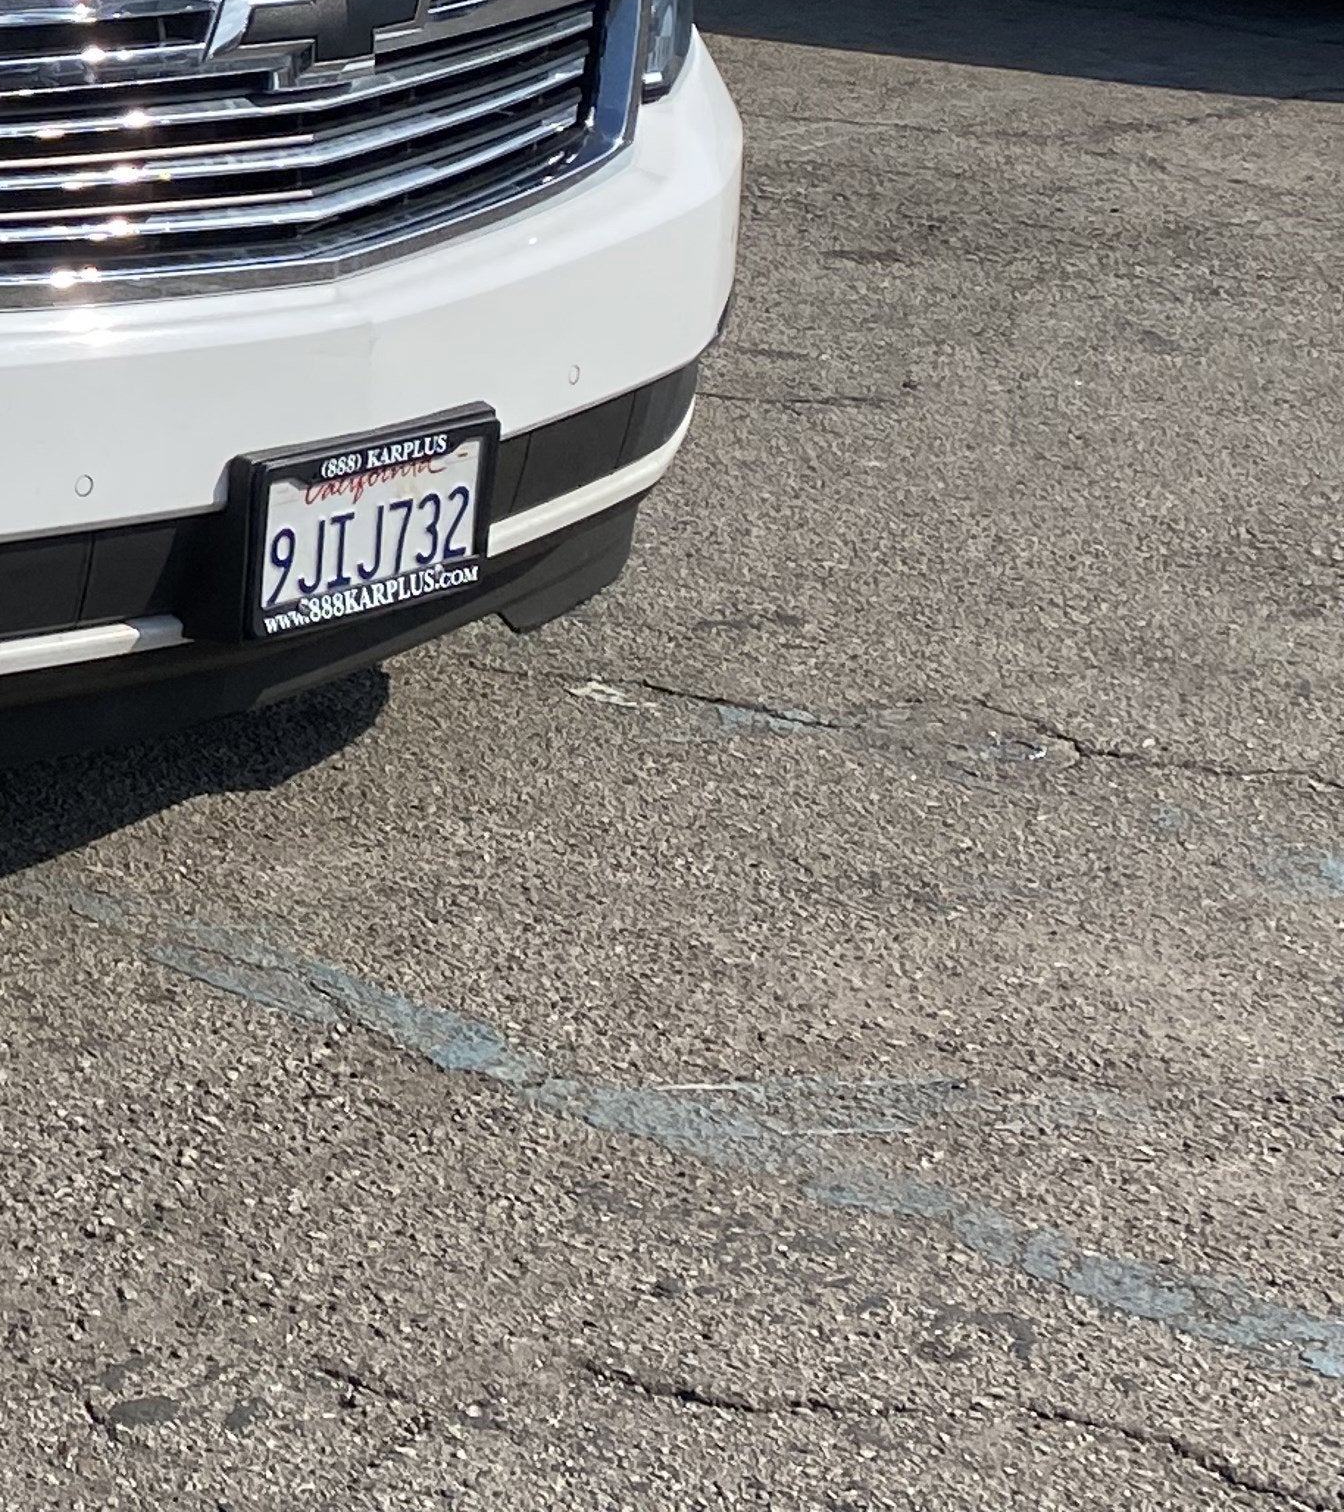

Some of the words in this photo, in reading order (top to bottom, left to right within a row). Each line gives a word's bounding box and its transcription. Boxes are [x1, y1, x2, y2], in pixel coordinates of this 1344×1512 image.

[320, 454, 362, 479] (888)
[366, 434, 448, 469] KARPLUS
[267, 485, 470, 607] 9JIJ732
